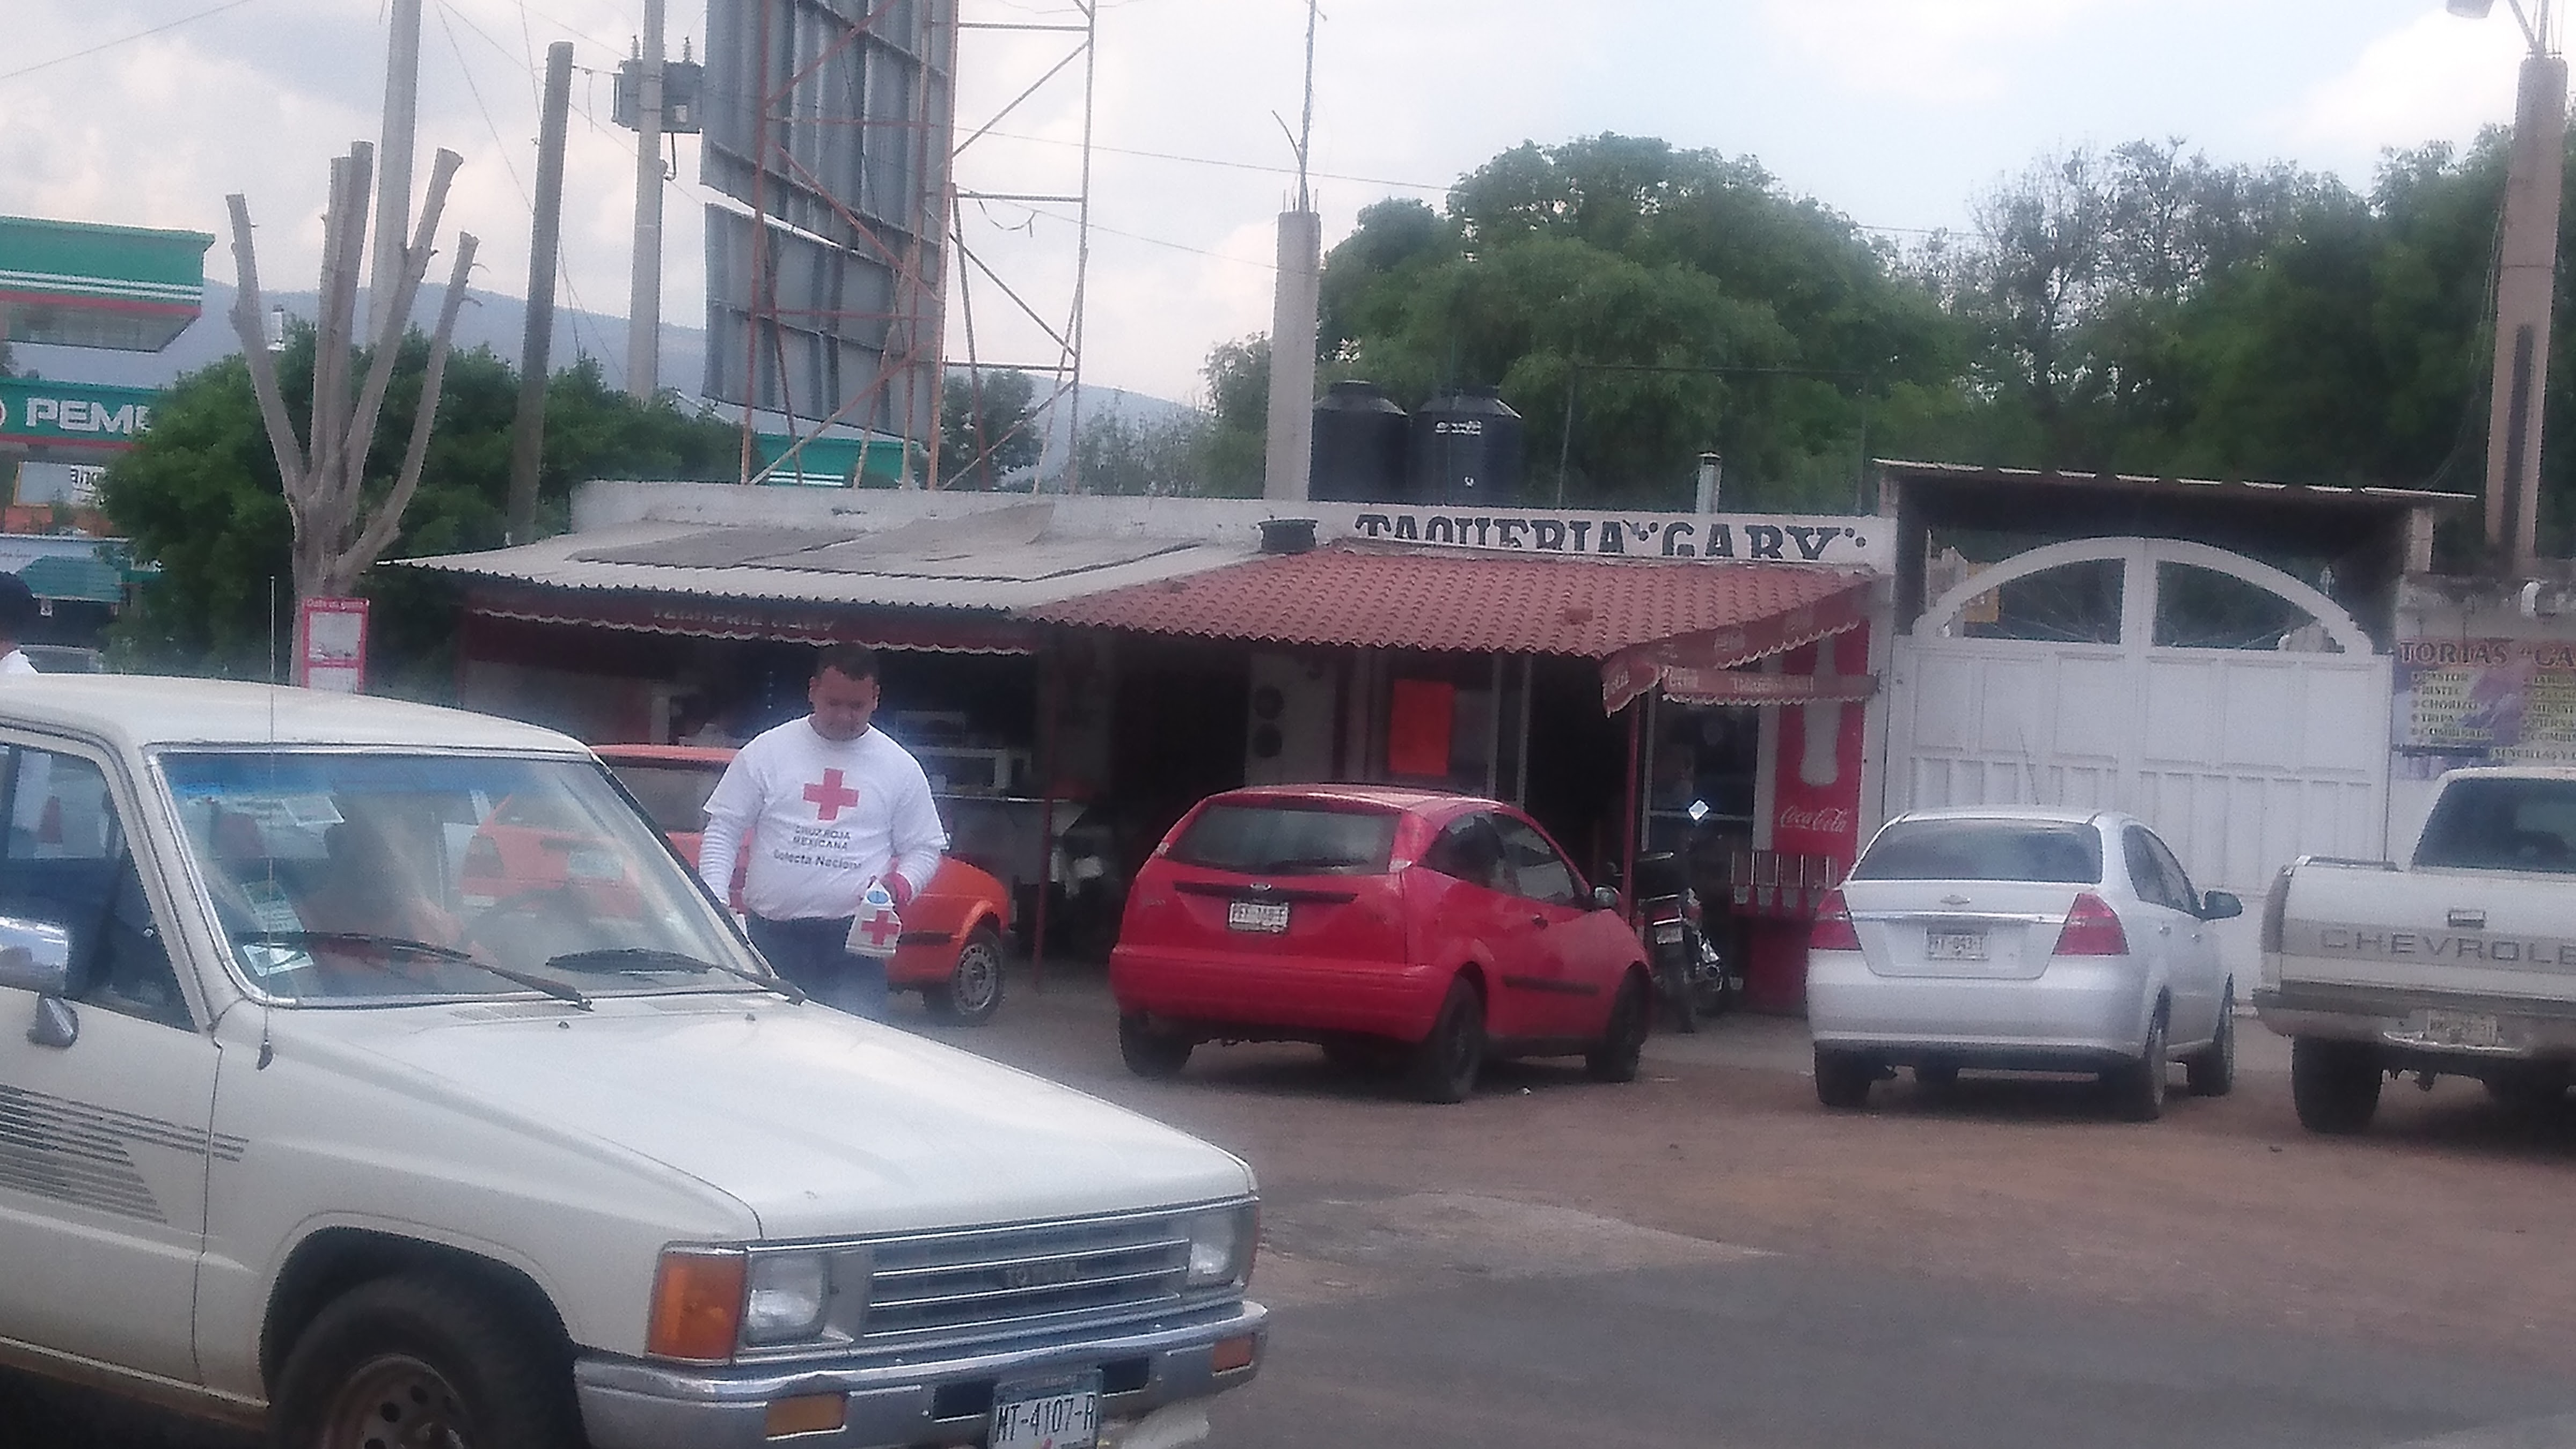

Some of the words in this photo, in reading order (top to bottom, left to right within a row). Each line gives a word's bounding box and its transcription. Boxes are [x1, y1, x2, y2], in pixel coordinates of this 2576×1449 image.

[792, 835, 848, 851] MEXICANA
[823, 829, 851, 840] ROJA
[1005, 1260, 1078, 1286] TOTA
[996, 1394, 1095, 1444] MT-4107-R
